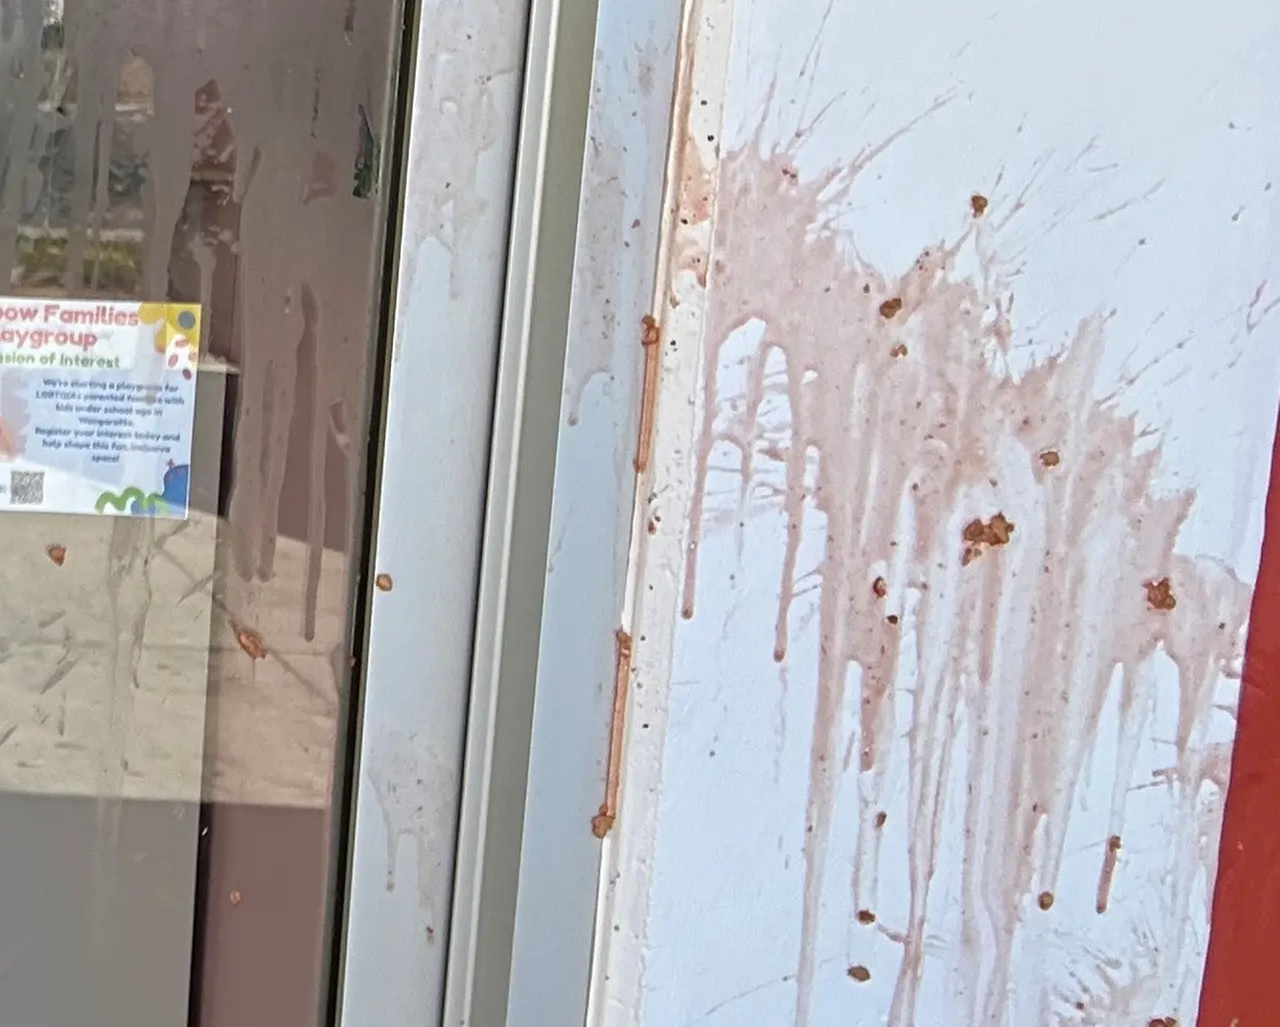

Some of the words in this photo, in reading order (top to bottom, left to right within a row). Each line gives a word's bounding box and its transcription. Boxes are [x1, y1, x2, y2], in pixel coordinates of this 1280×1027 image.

[43, 304, 140, 326] Families
[40, 352, 55, 366] of
[60, 353, 120, 369] Interest
